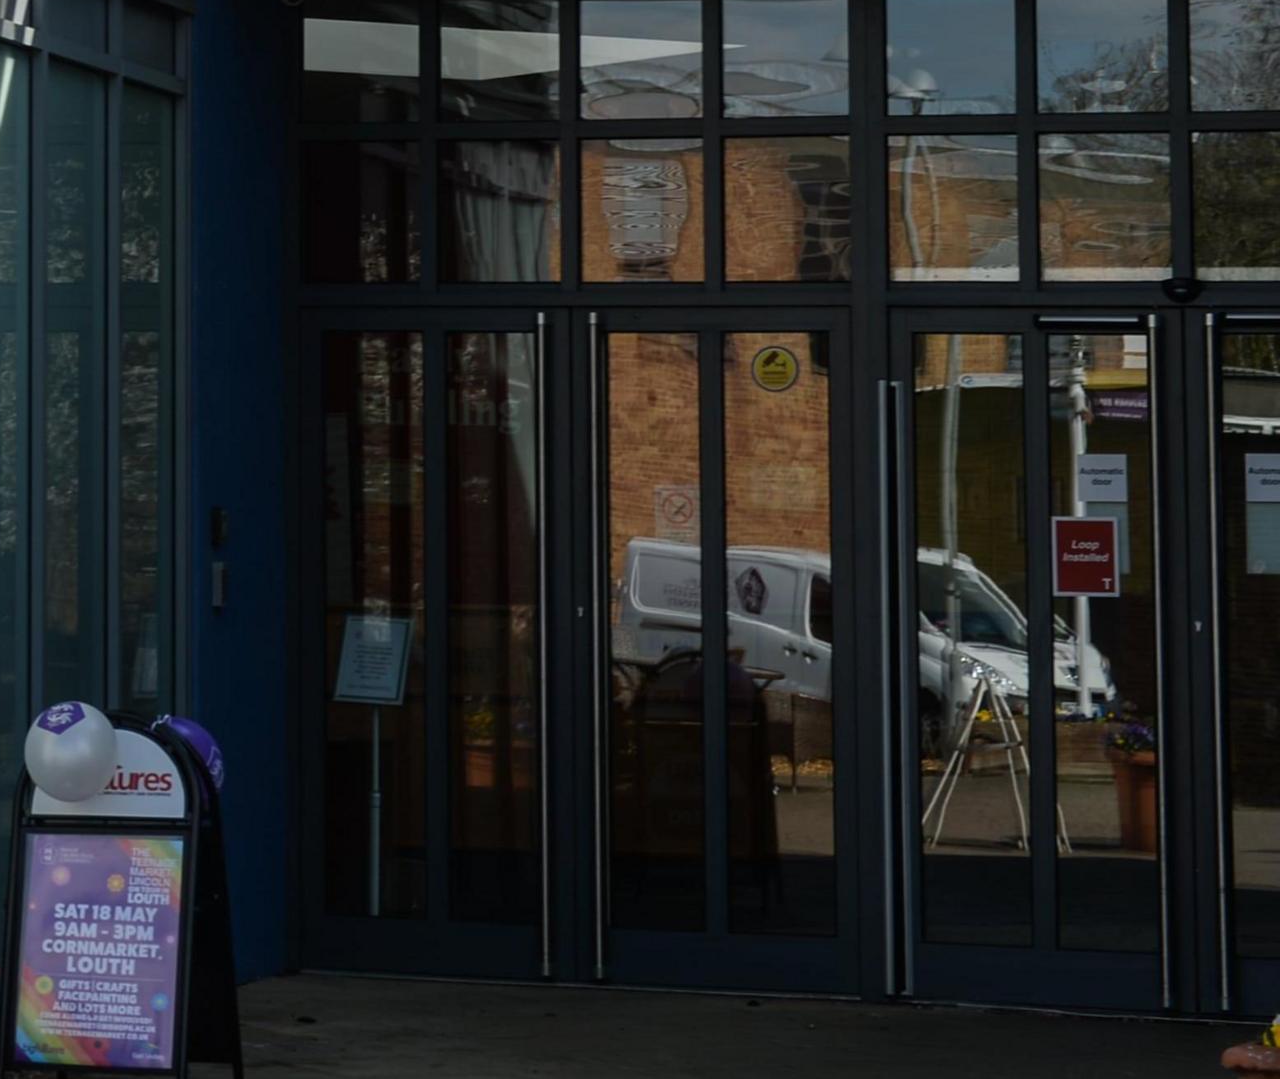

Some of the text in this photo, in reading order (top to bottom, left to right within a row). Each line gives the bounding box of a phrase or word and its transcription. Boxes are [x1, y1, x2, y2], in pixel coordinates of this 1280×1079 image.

[1079, 467, 1124, 475] Automatic
[1091, 477, 1112, 485] door
[1071, 539, 1100, 551] Loop
[127, 892, 170, 905] LOUTH
[54, 903, 158, 923] SAT 18 MAY
[54, 921, 98, 938] 9AM
[113, 924, 154, 941] 3PM
[66, 956, 136, 976] LOUTH
[58, 979, 139, 993] GIFTS CRAFTS
[57, 990, 137, 1005] FACEPAINTING
[52, 1001, 142, 1016] AND LOTS MORE
